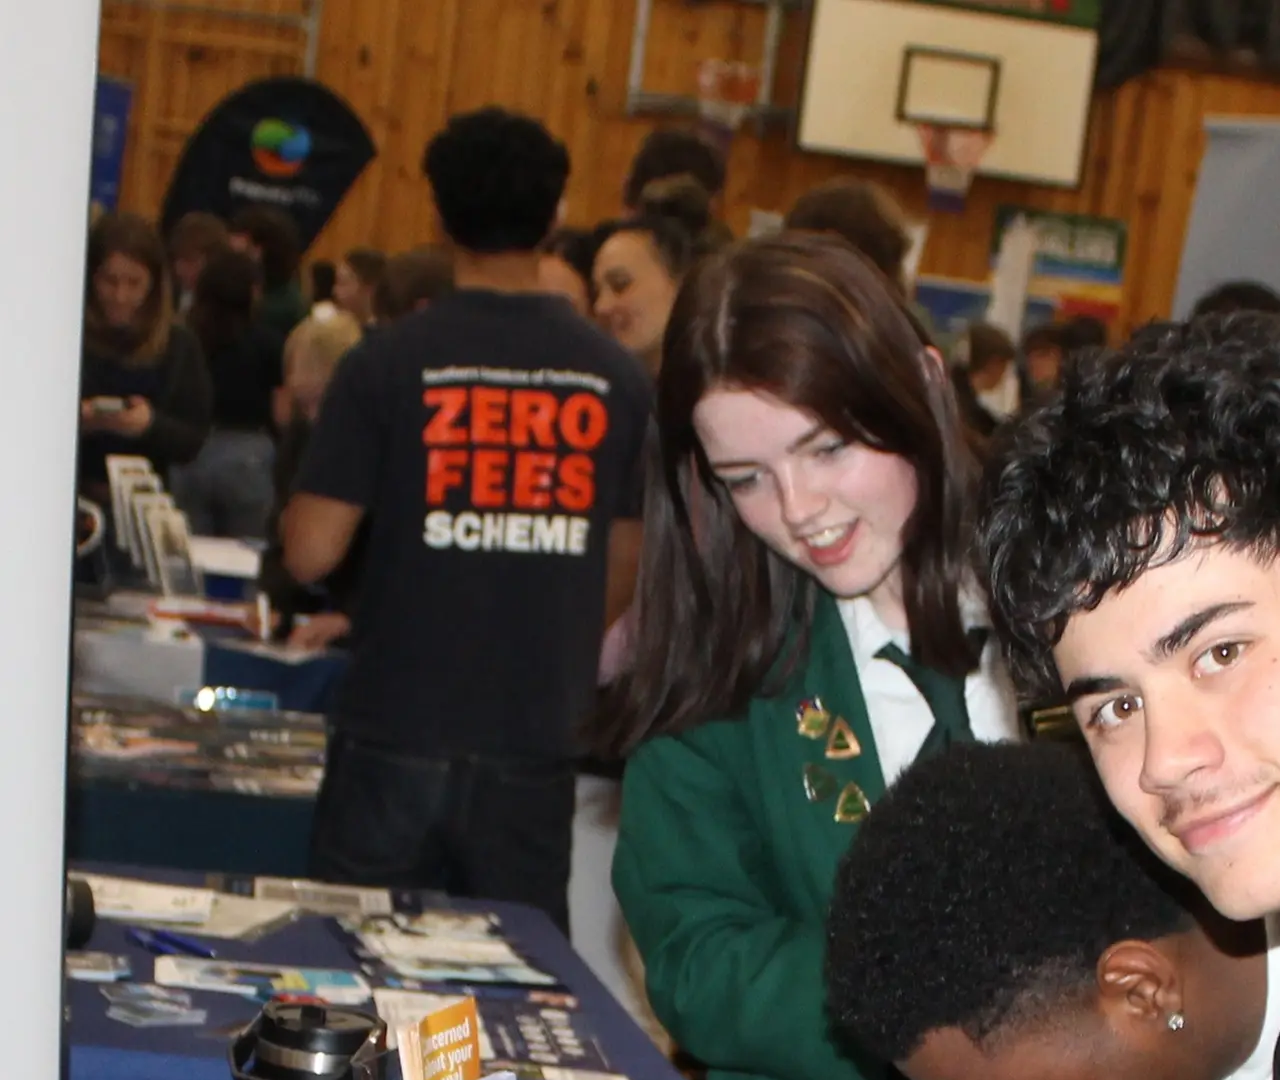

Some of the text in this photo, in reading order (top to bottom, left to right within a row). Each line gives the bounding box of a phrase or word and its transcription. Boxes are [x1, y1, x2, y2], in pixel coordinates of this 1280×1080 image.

[423, 386, 608, 450] ZERO
[426, 450, 595, 510] FEES
[422, 510, 589, 556] SCHEME
[448, 1043, 473, 1073] your
